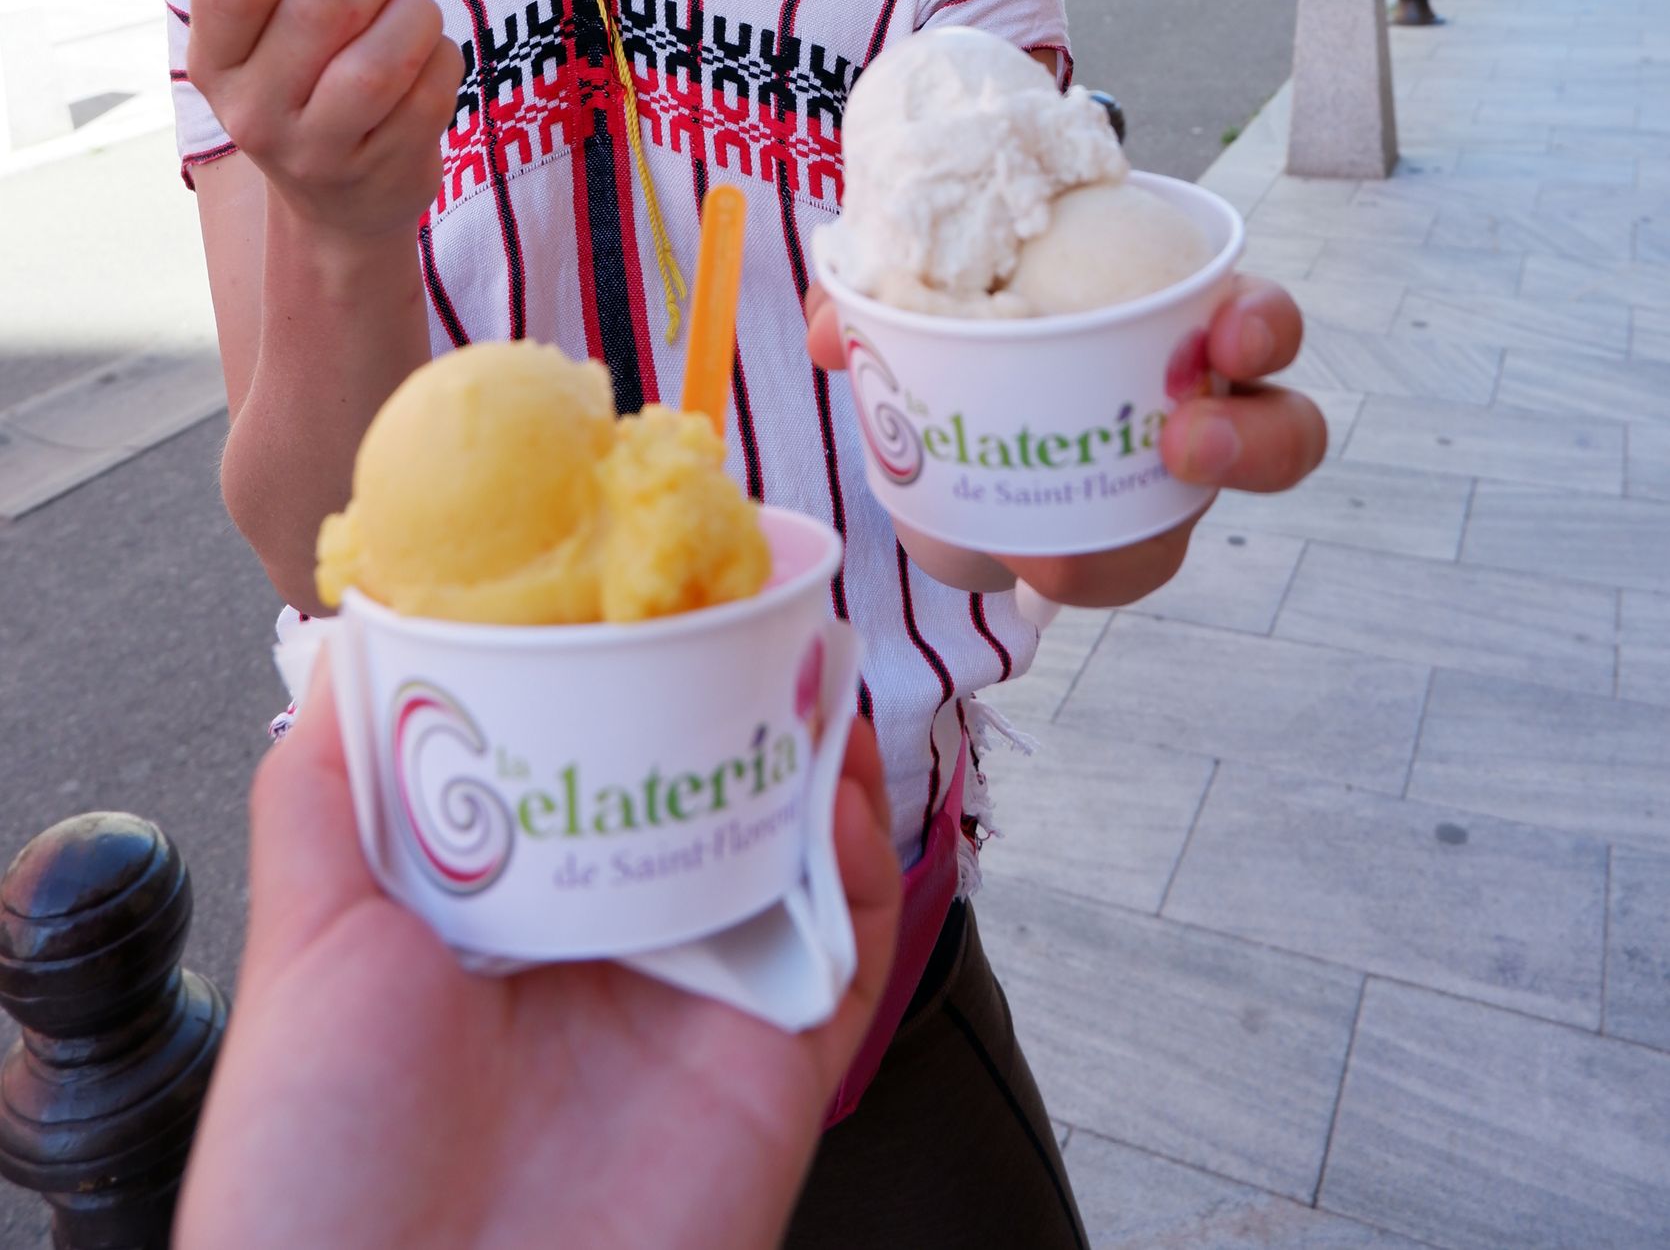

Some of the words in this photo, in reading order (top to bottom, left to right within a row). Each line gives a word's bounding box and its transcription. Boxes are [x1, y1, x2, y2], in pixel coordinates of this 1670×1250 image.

[953, 473, 986, 502] de
[995, 463, 1168, 507] Saint-Floren
[496, 746, 532, 780] la
[552, 850, 599, 889] de
